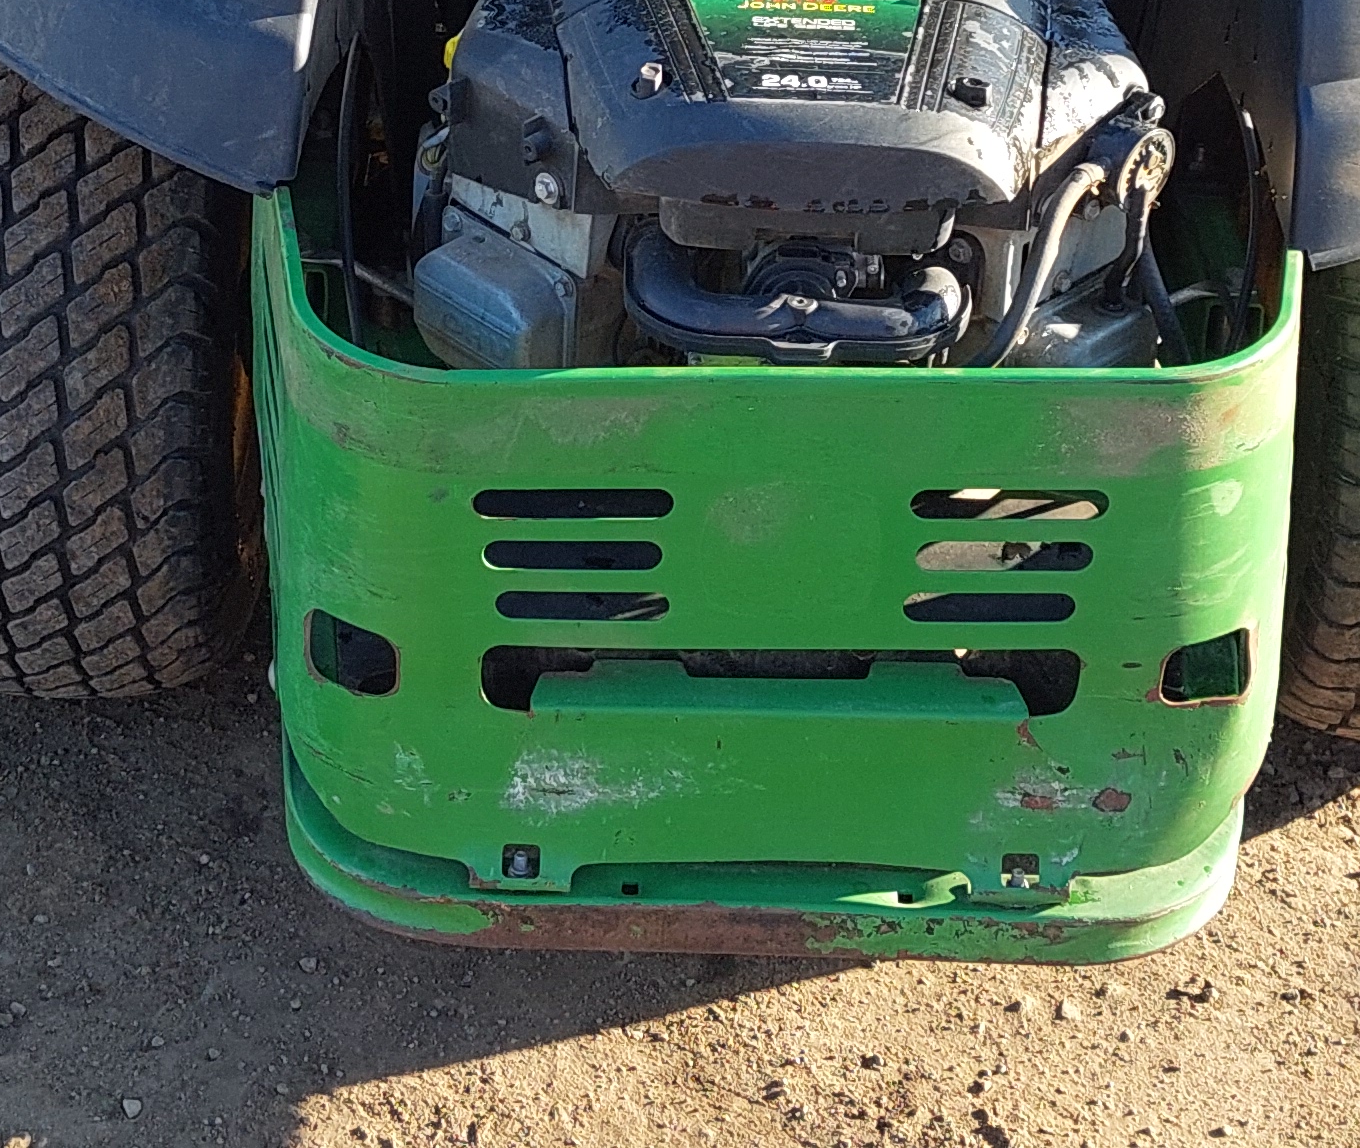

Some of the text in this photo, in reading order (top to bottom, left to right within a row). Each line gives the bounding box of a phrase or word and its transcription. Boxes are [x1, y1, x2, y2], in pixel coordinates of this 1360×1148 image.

[737, 0, 876, 14] JOHN DEERE
[751, 15, 856, 26] EXTENDED
[761, 73, 828, 88] 24.0
